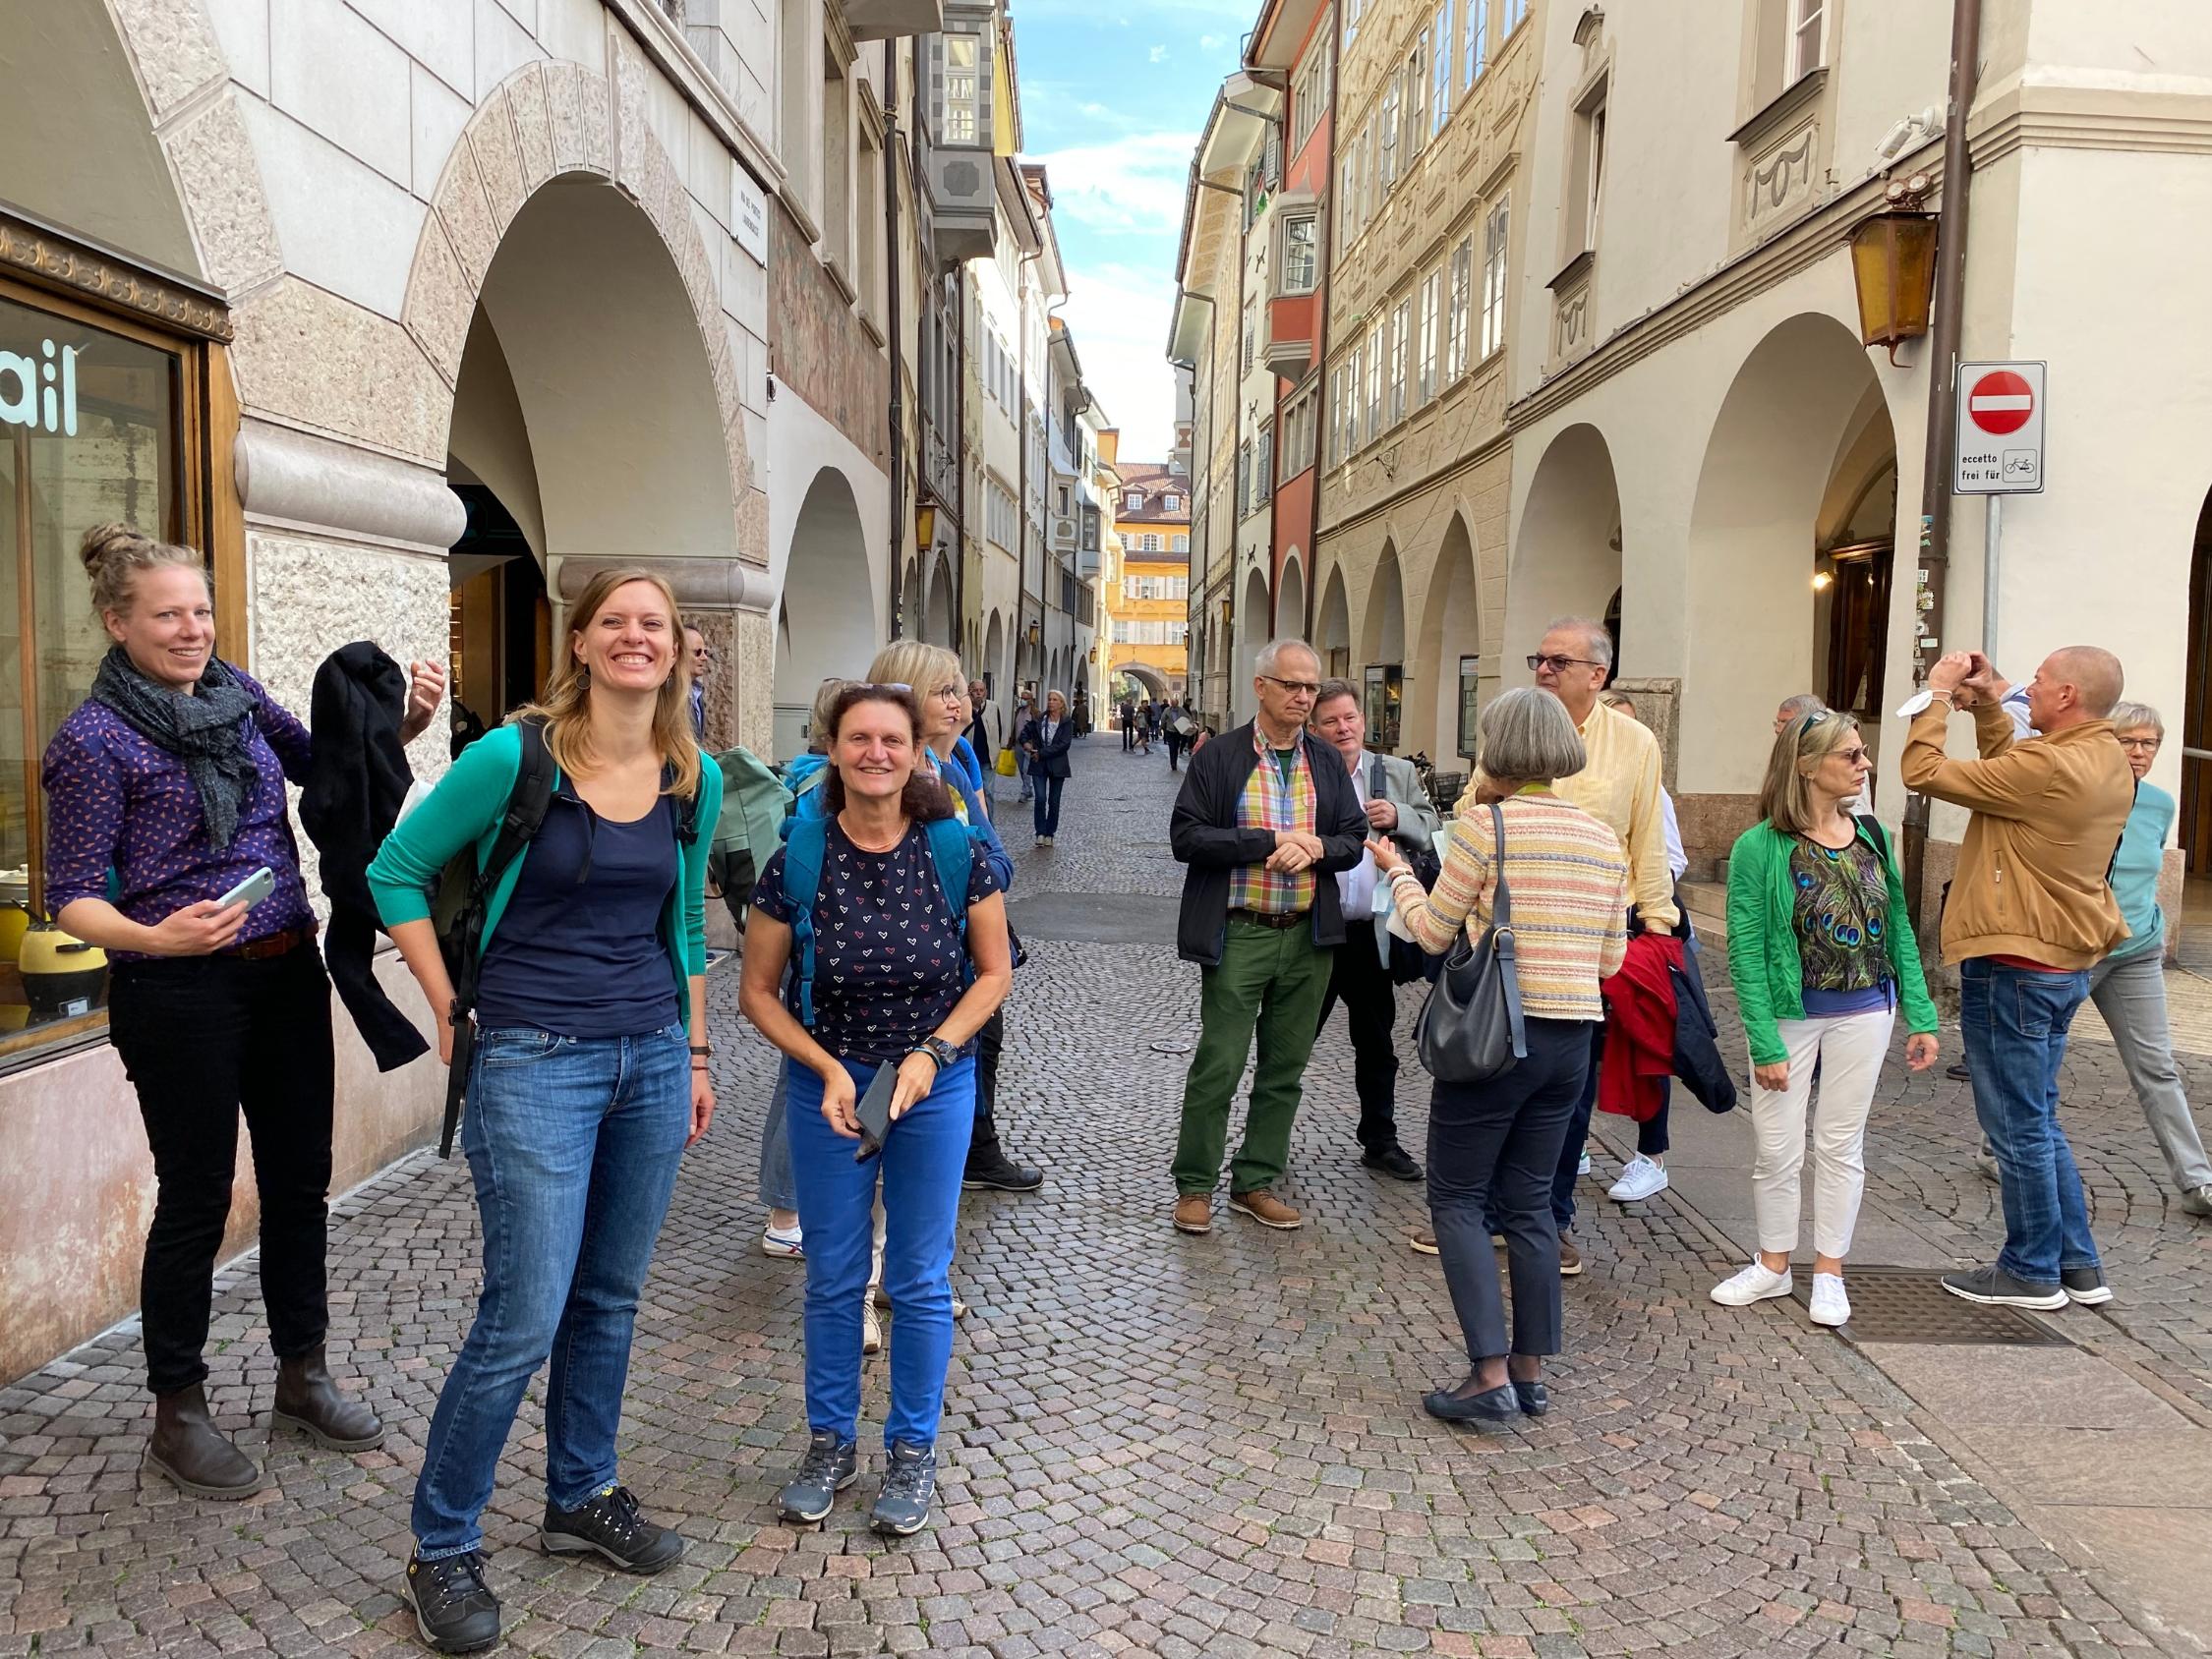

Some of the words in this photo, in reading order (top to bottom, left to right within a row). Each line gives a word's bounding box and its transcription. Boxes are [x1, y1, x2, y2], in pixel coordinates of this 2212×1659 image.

[1962, 454, 1998, 463] eccetto
[1962, 470, 1979, 480] frei
[1985, 470, 2000, 480] für
